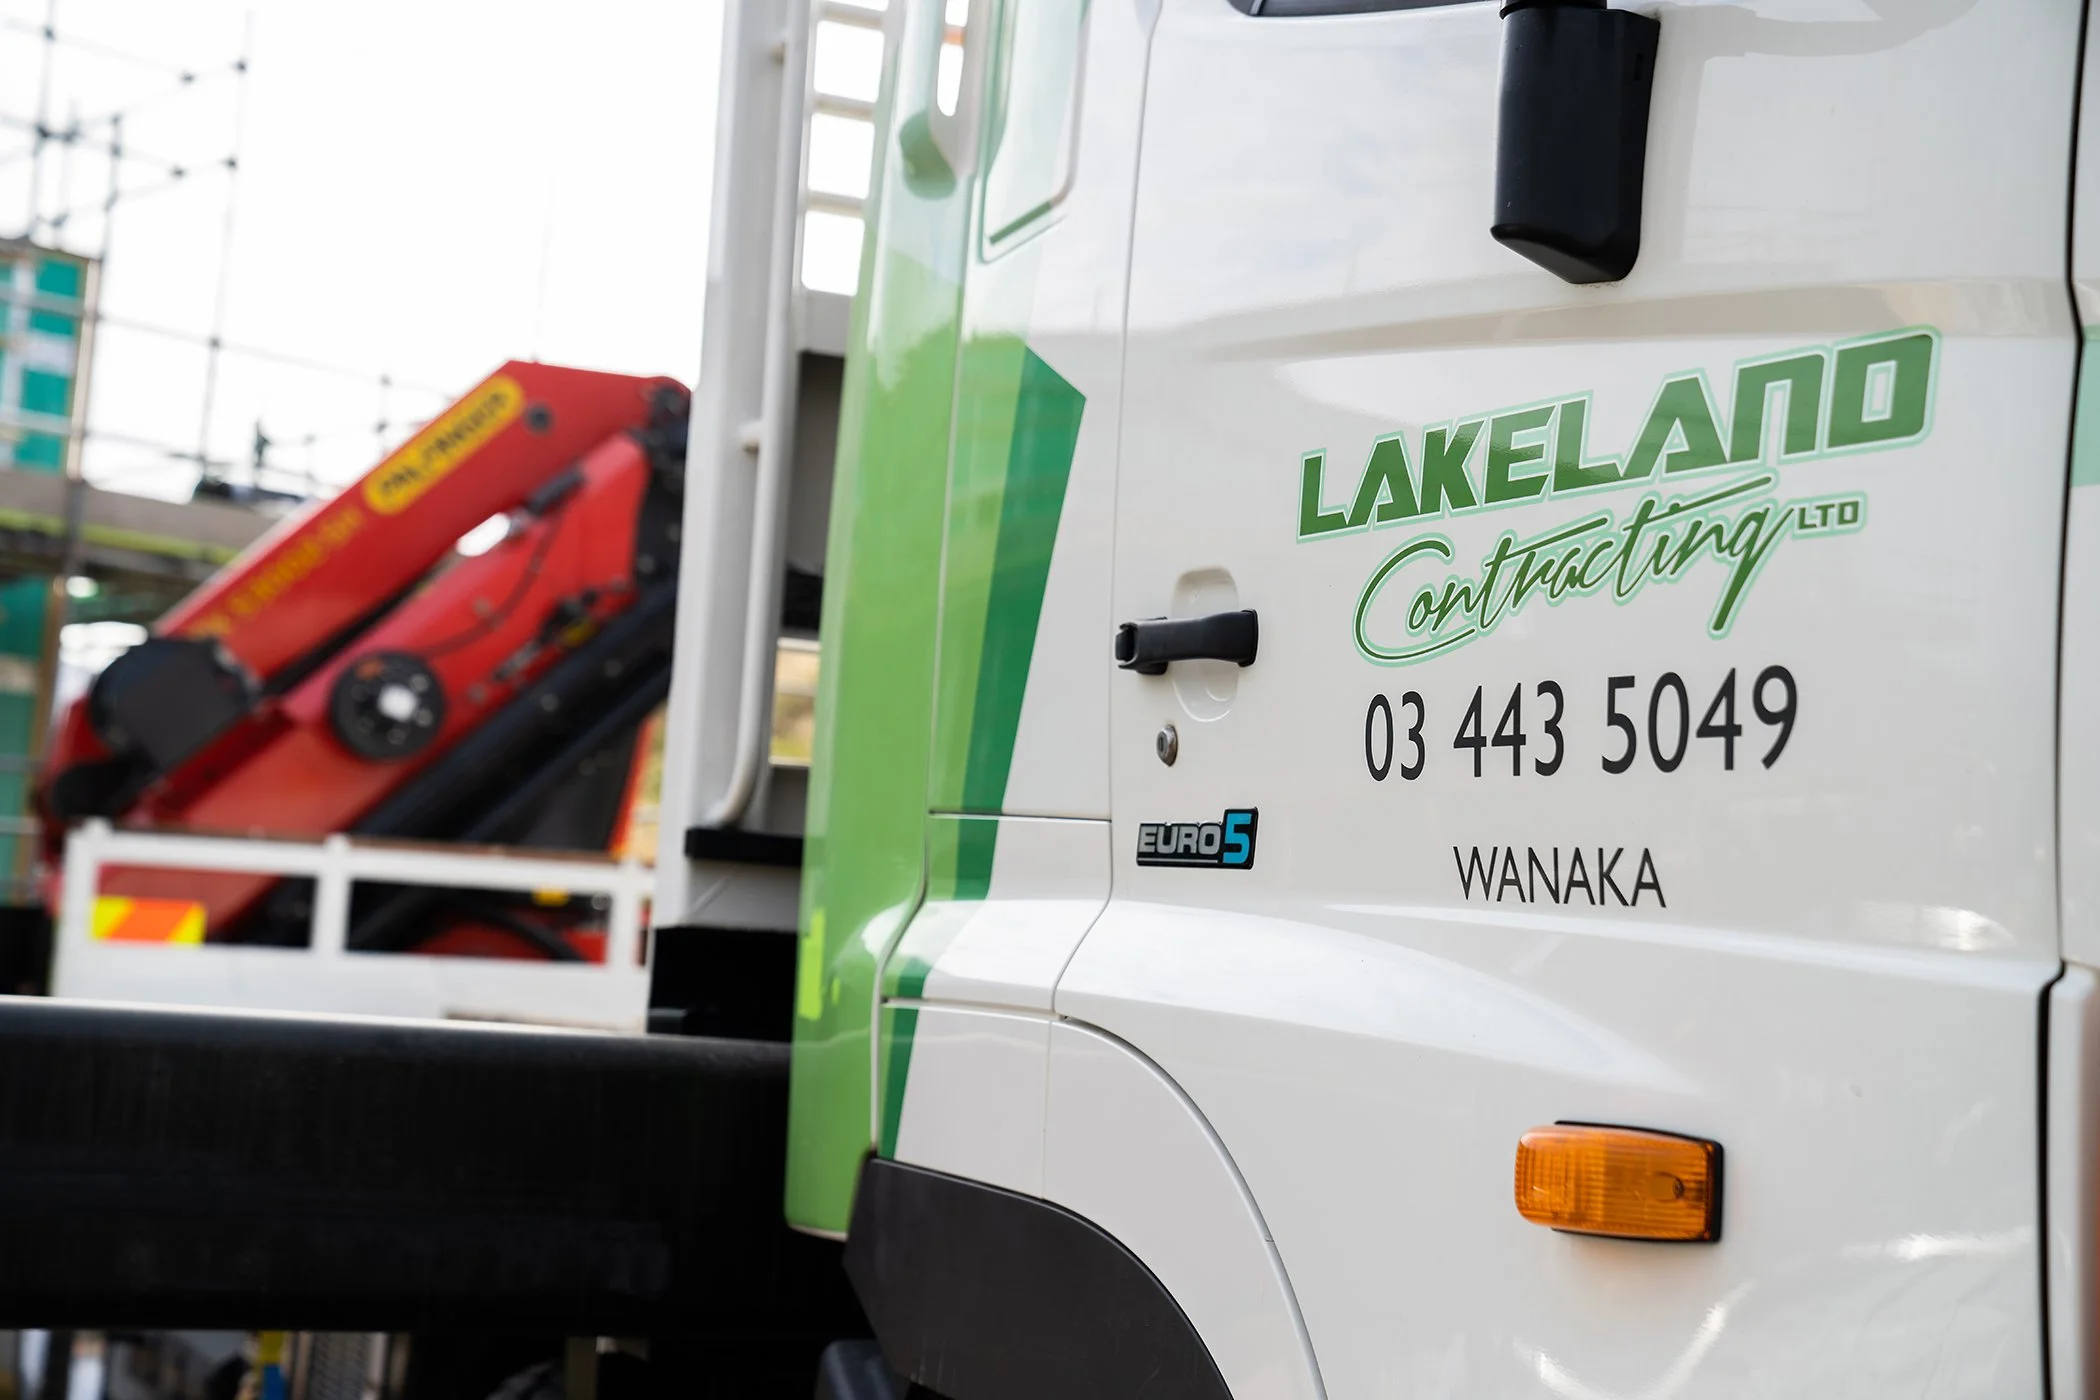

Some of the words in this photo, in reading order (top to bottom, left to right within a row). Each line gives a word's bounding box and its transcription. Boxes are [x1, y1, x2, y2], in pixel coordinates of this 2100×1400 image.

[1298, 331, 1936, 538] LAKELAND
[1355, 474, 1795, 660] Contracting
[1796, 499, 1860, 530] LTD
[1364, 690, 1426, 781] 03
[1452, 679, 1565, 777] 443
[1601, 664, 1798, 774] 5049
[1452, 845, 1667, 908] WANAKA
